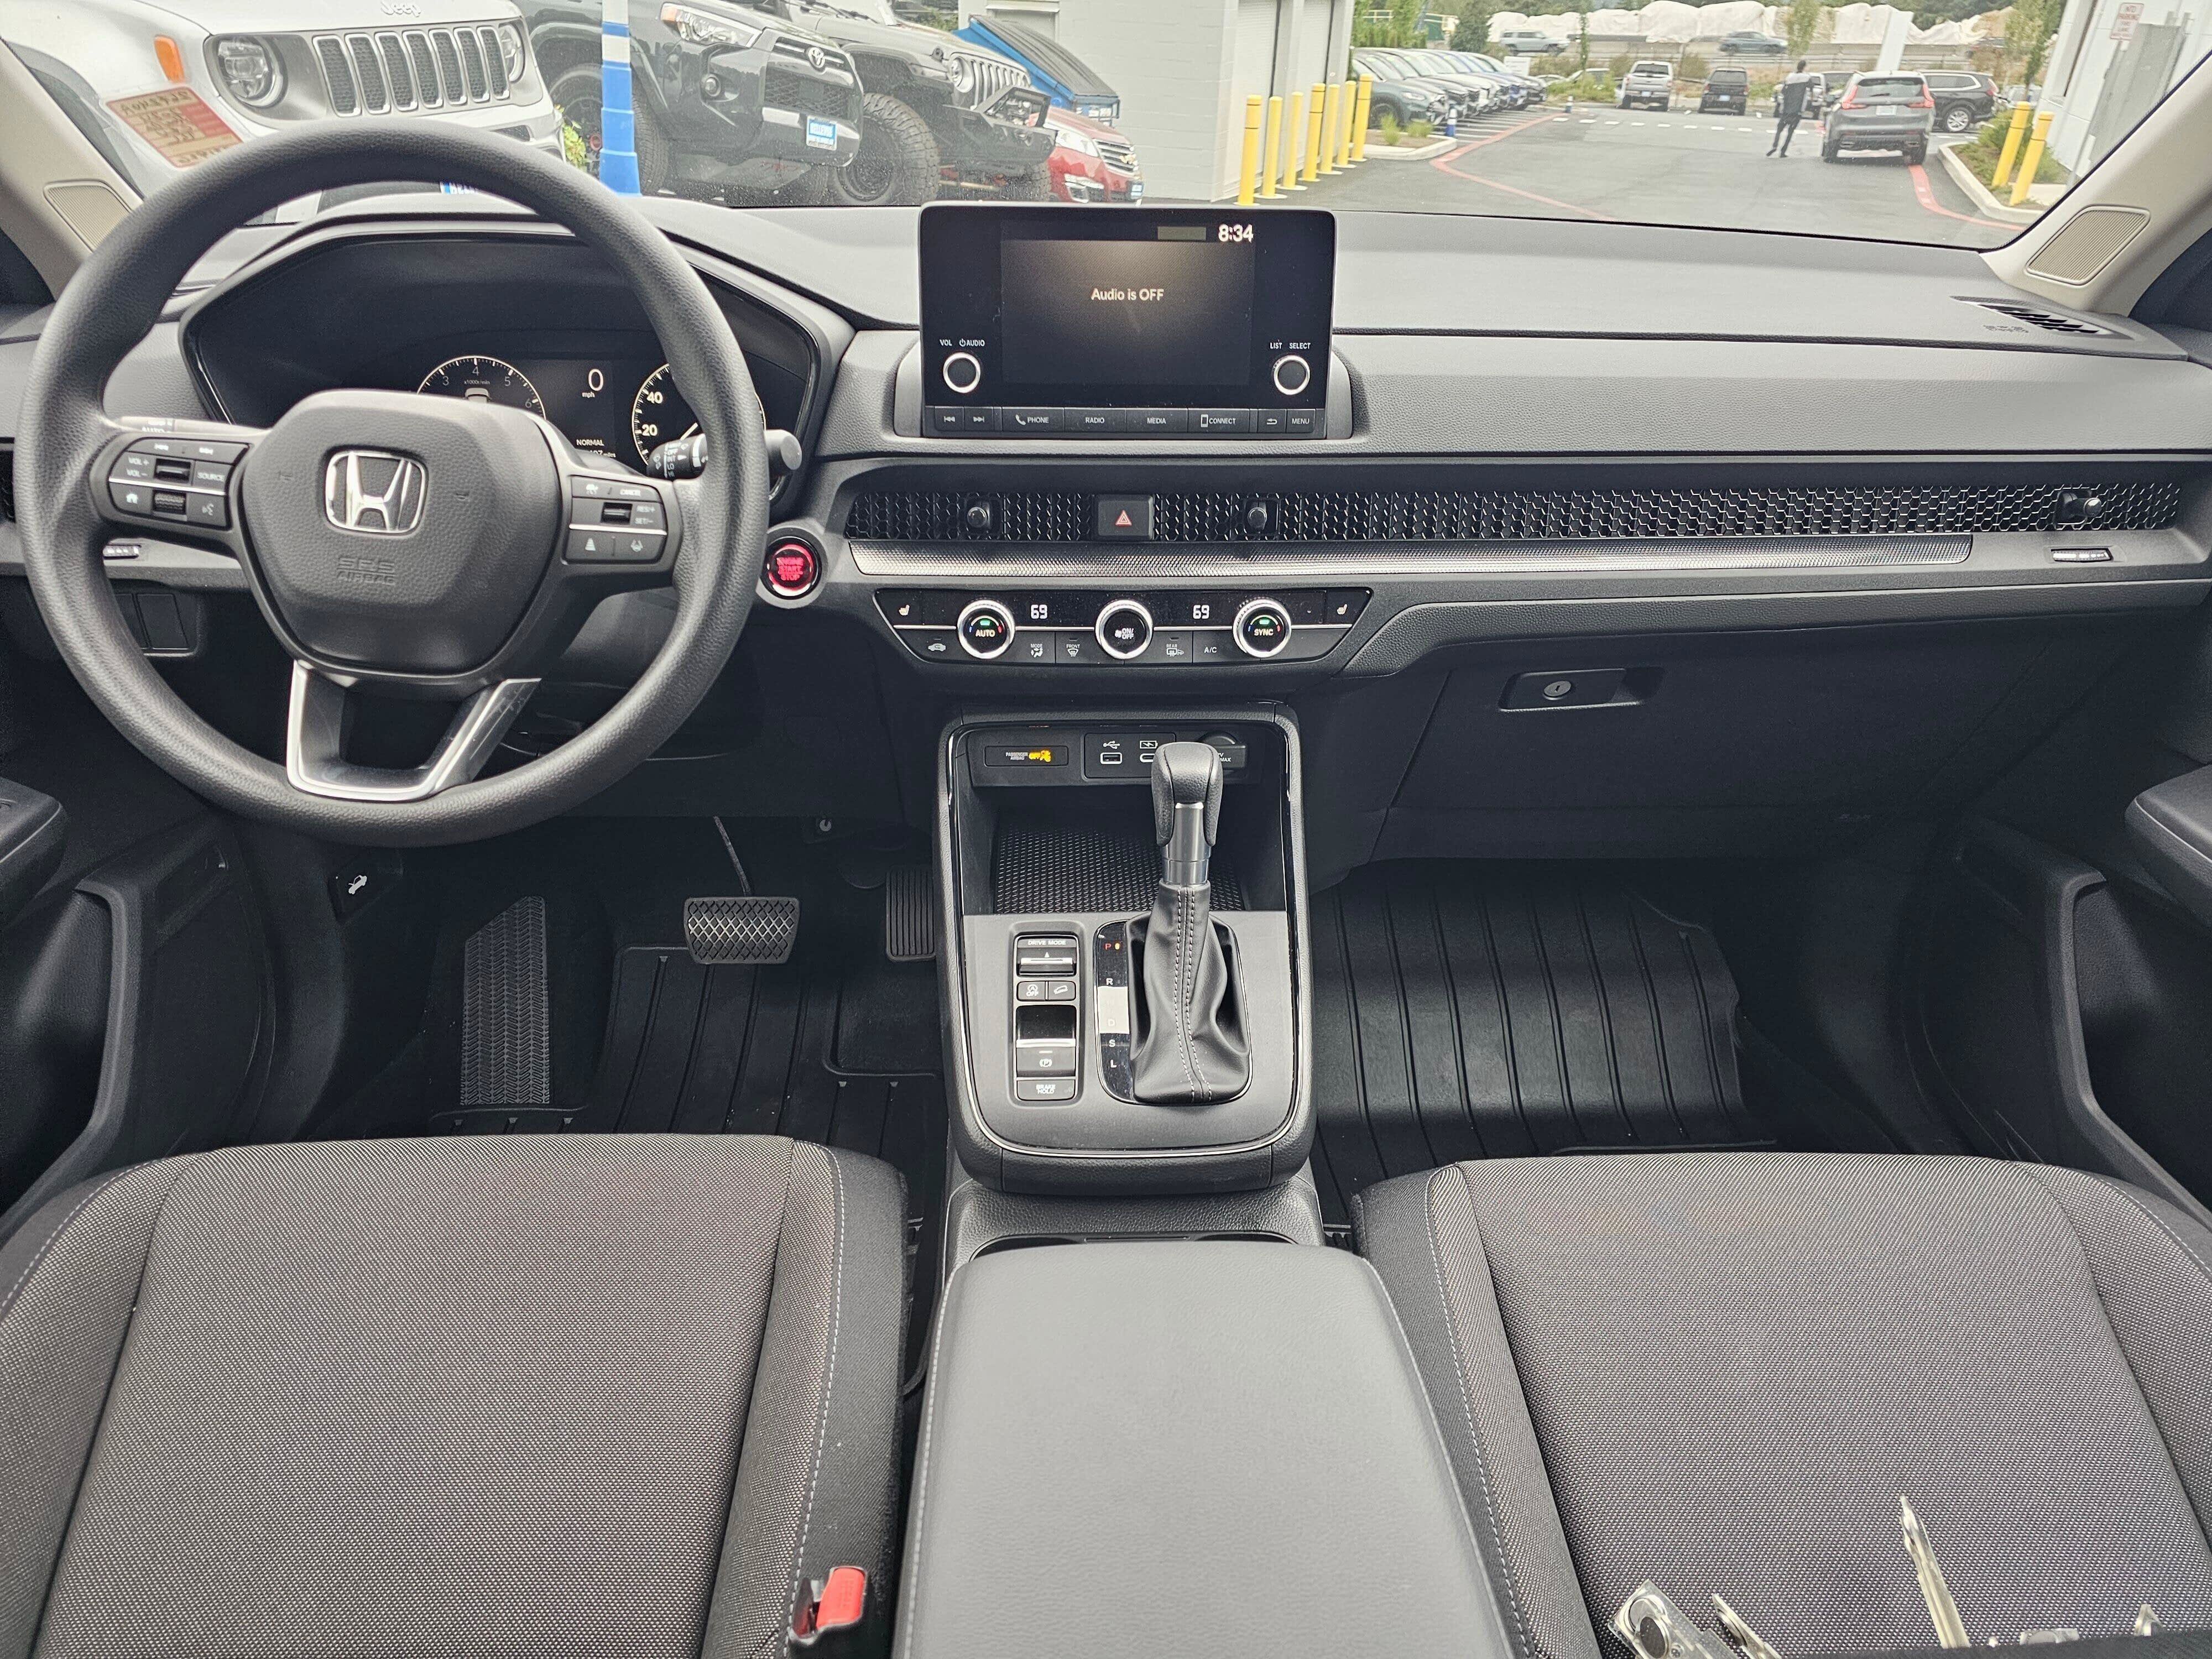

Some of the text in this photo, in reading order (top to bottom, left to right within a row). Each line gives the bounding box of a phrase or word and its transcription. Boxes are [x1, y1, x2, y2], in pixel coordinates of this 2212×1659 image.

[380, 1, 422, 18] Jeep
[1218, 223, 1254, 242] 8:34
[1091, 288, 1164, 301] Audio is OFF
[472, 366, 479, 376] 4
[442, 377, 450, 386] 3
[504, 376, 511, 387] 5
[588, 368, 604, 392] 0
[525, 398, 532, 408] 6
[646, 392, 664, 404] 40
[641, 424, 659, 436] 20
[197, 472, 225, 482] SOURCE
[337, 555, 395, 571] SRS
[778, 566, 804, 575] START
[336, 571, 397, 585] AIRBAG
[1030, 604, 1048, 619] 69
[1193, 604, 1210, 620] 69
[975, 629, 995, 637] AUTO
[1105, 978, 1114, 986] R
[1107, 1019, 1115, 1027] D
[1108, 1039, 1116, 1047] S
[1110, 1060, 1118, 1068] L
